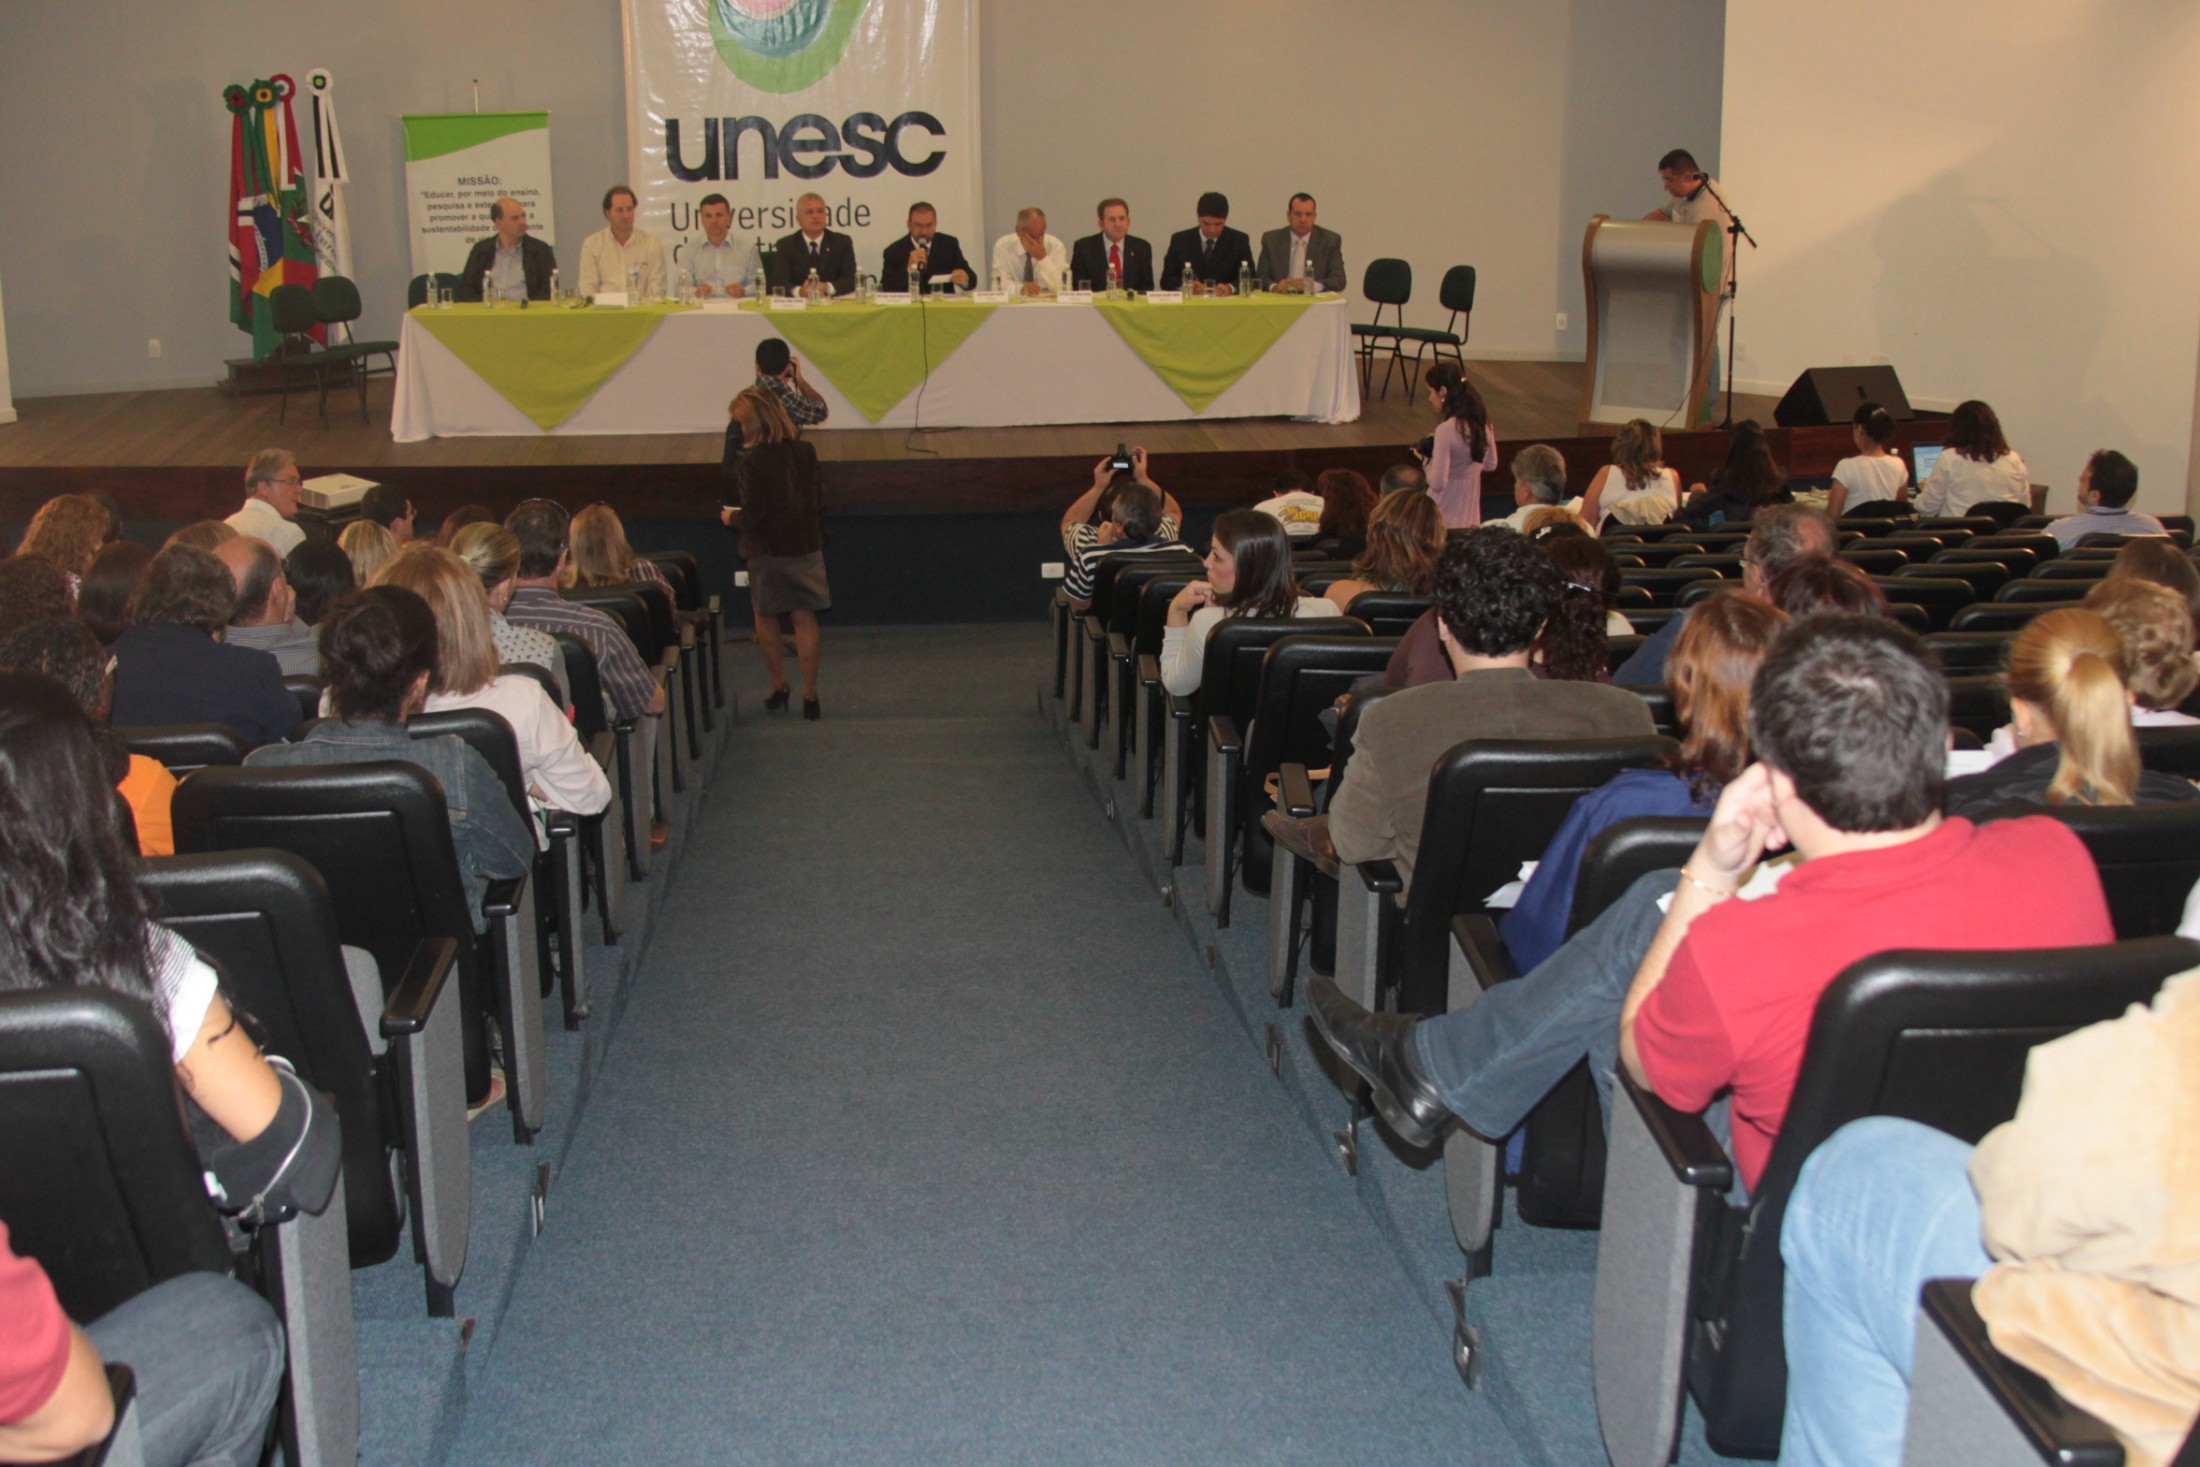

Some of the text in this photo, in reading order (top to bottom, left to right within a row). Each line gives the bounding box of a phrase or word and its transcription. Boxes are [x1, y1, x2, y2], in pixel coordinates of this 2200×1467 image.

[665, 111, 947, 182] unesc
[458, 191, 471, 199] por
[497, 189, 508, 197] do
[427, 203, 465, 211] pesquisa
[429, 214, 468, 222] promover
[671, 197, 871, 231] Uversiade
[422, 224, 490, 233] sustentabilidade
